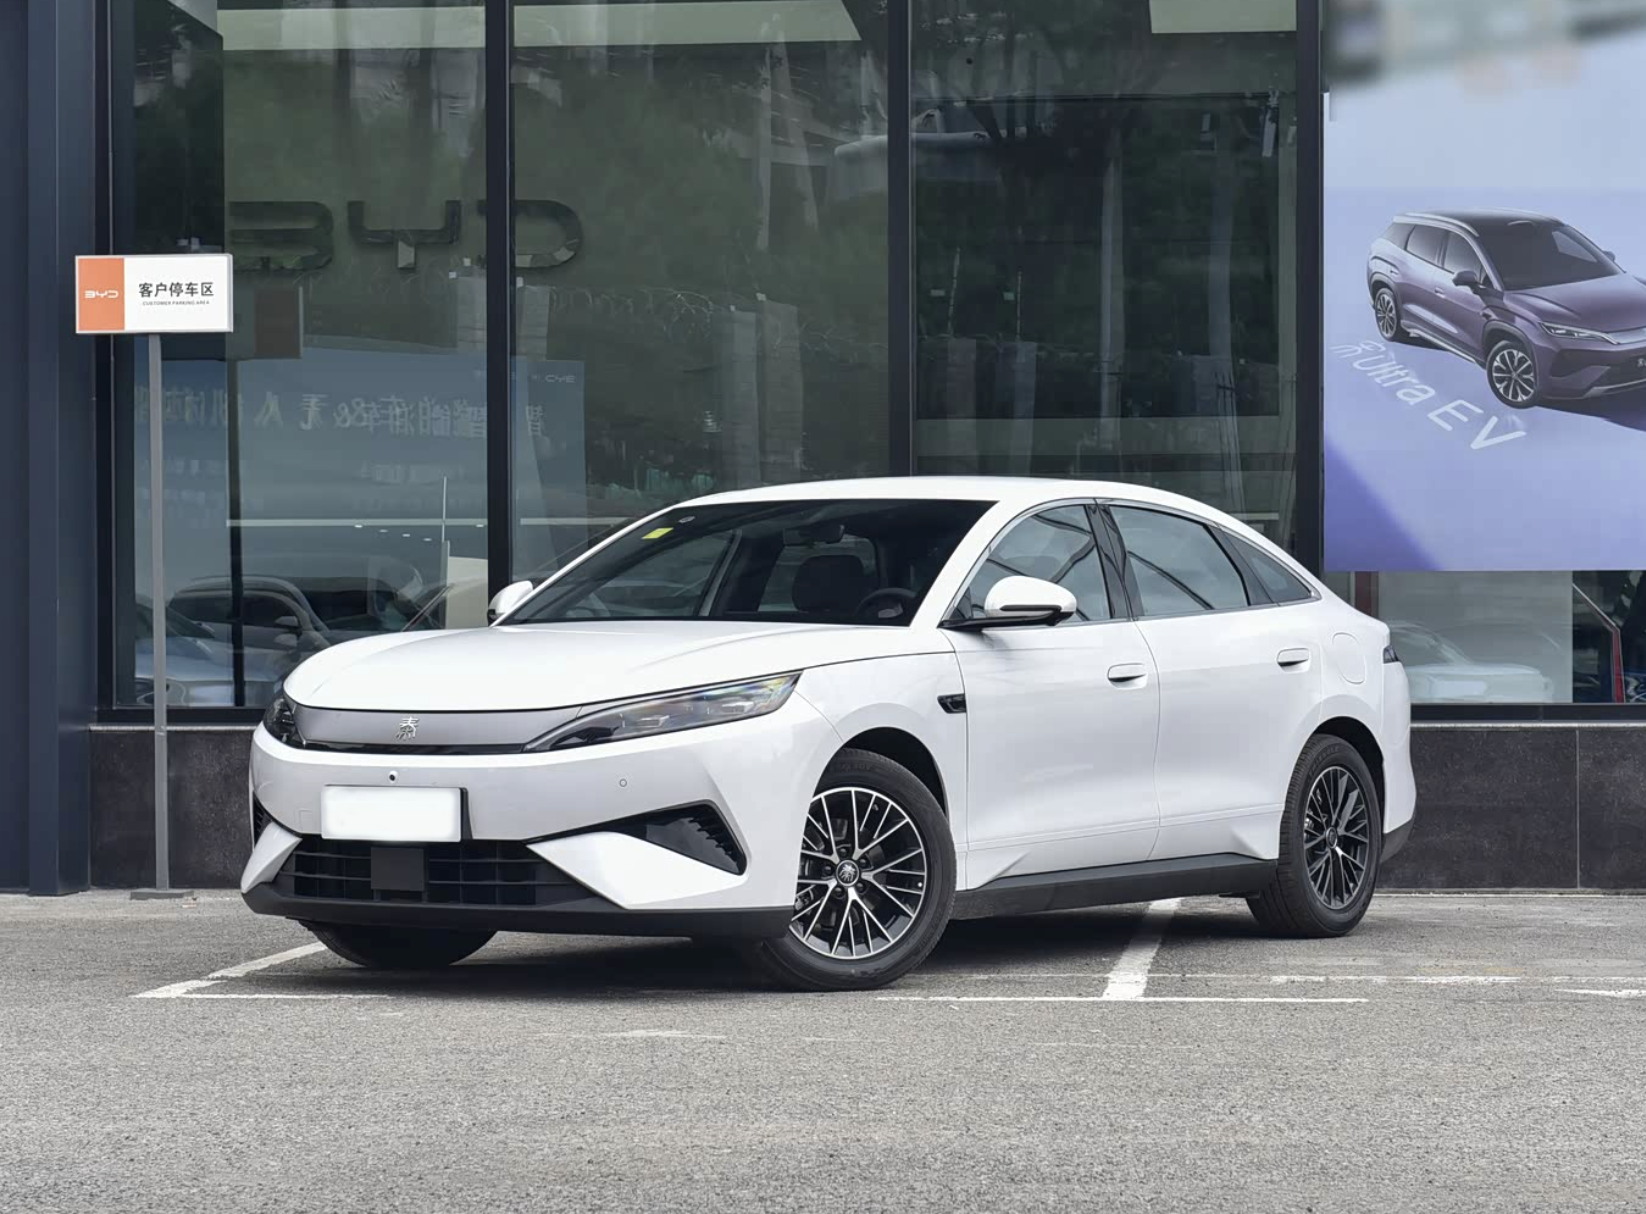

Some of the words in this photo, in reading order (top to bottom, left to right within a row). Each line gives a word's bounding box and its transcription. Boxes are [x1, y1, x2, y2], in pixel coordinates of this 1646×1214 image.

[229, 200, 583, 269] BYD
[84, 289, 119, 299] BYD
[138, 281, 214, 298] 客户停车区
[1426, 399, 1527, 450] EV
